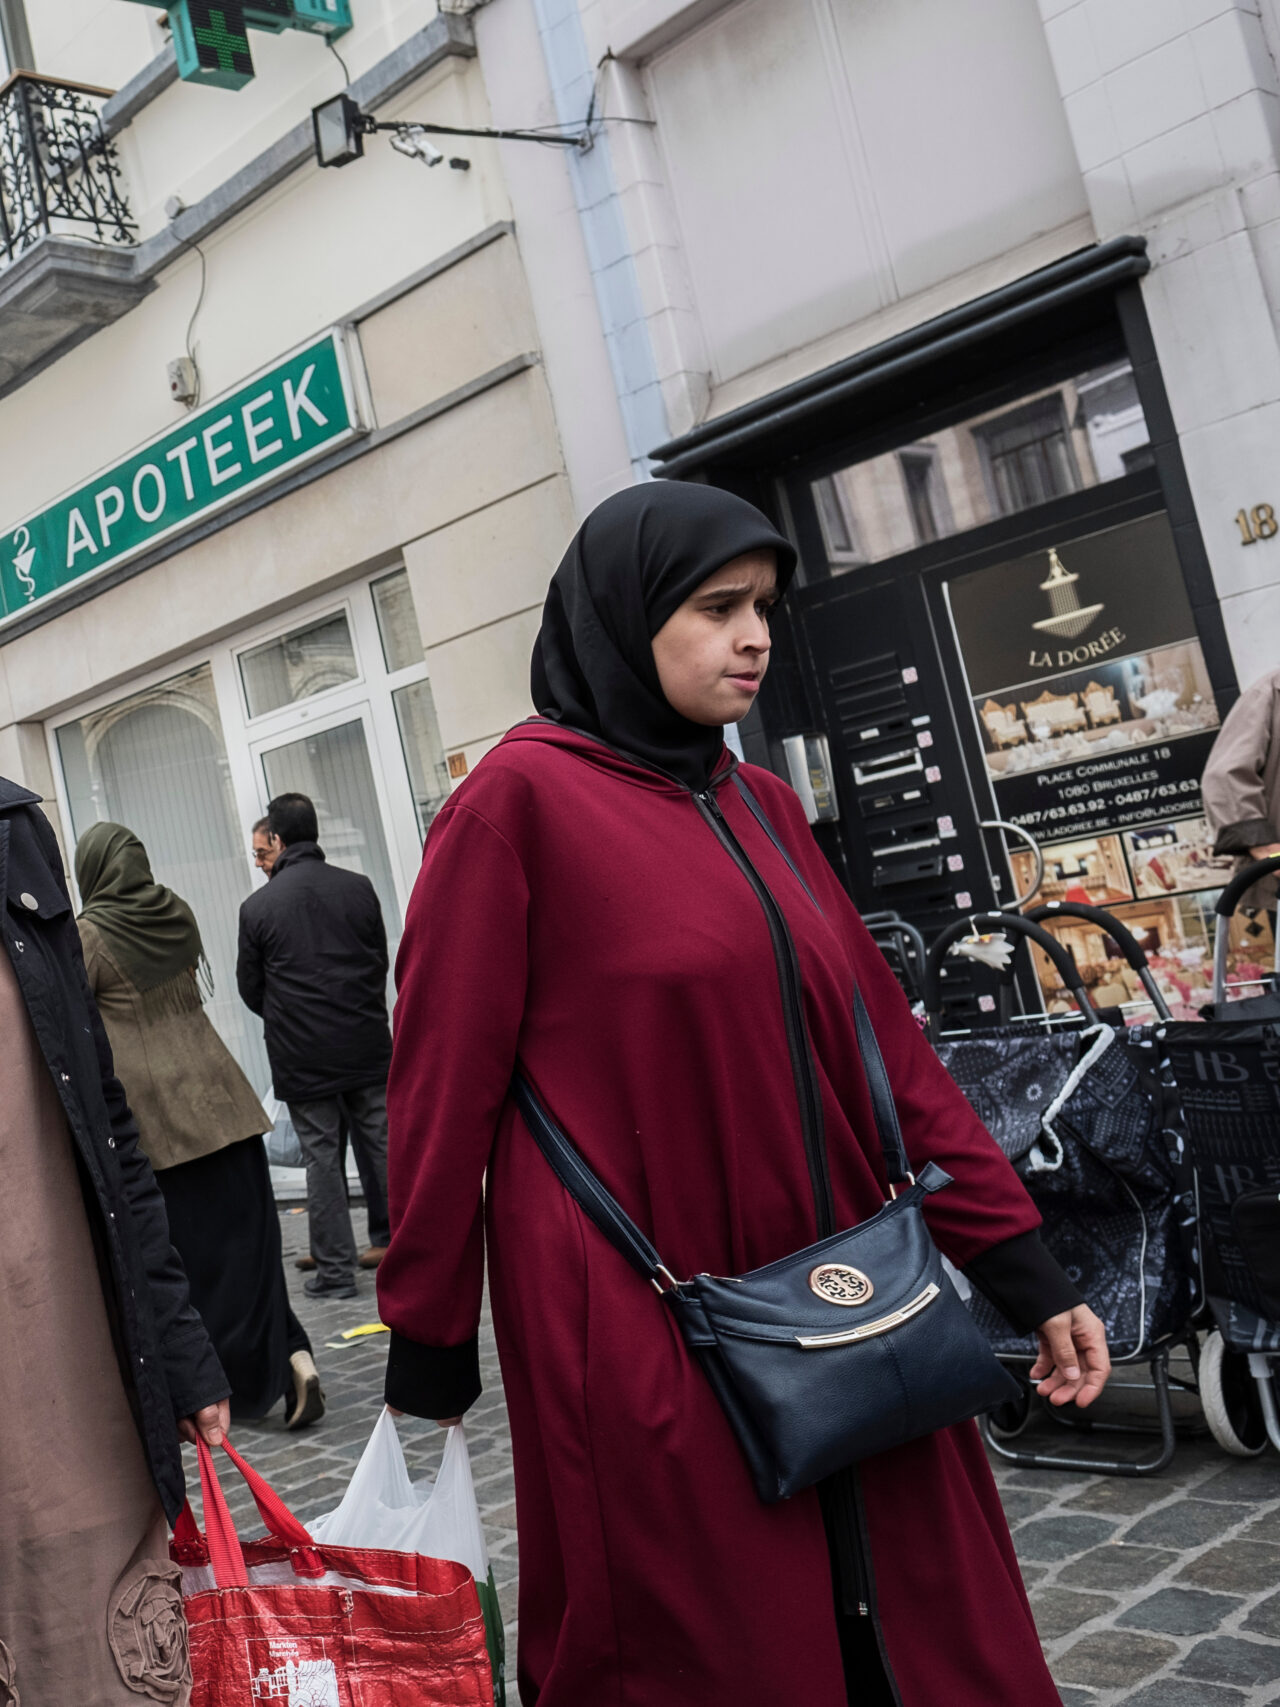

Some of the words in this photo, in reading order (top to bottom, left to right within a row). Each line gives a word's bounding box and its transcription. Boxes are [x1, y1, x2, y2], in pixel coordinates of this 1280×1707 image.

[66, 364, 328, 567] APOTEEK
[1234, 503, 1279, 547] 18
[1029, 650, 1053, 668] LA
[1057, 626, 1126, 667] DORÉE
[1153, 747, 1171, 760] 18
[1058, 784, 1090, 800] 1080
[1093, 770, 1159, 793] BRUXELLES
[1010, 798, 1106, 827] 0487/63.63.92
